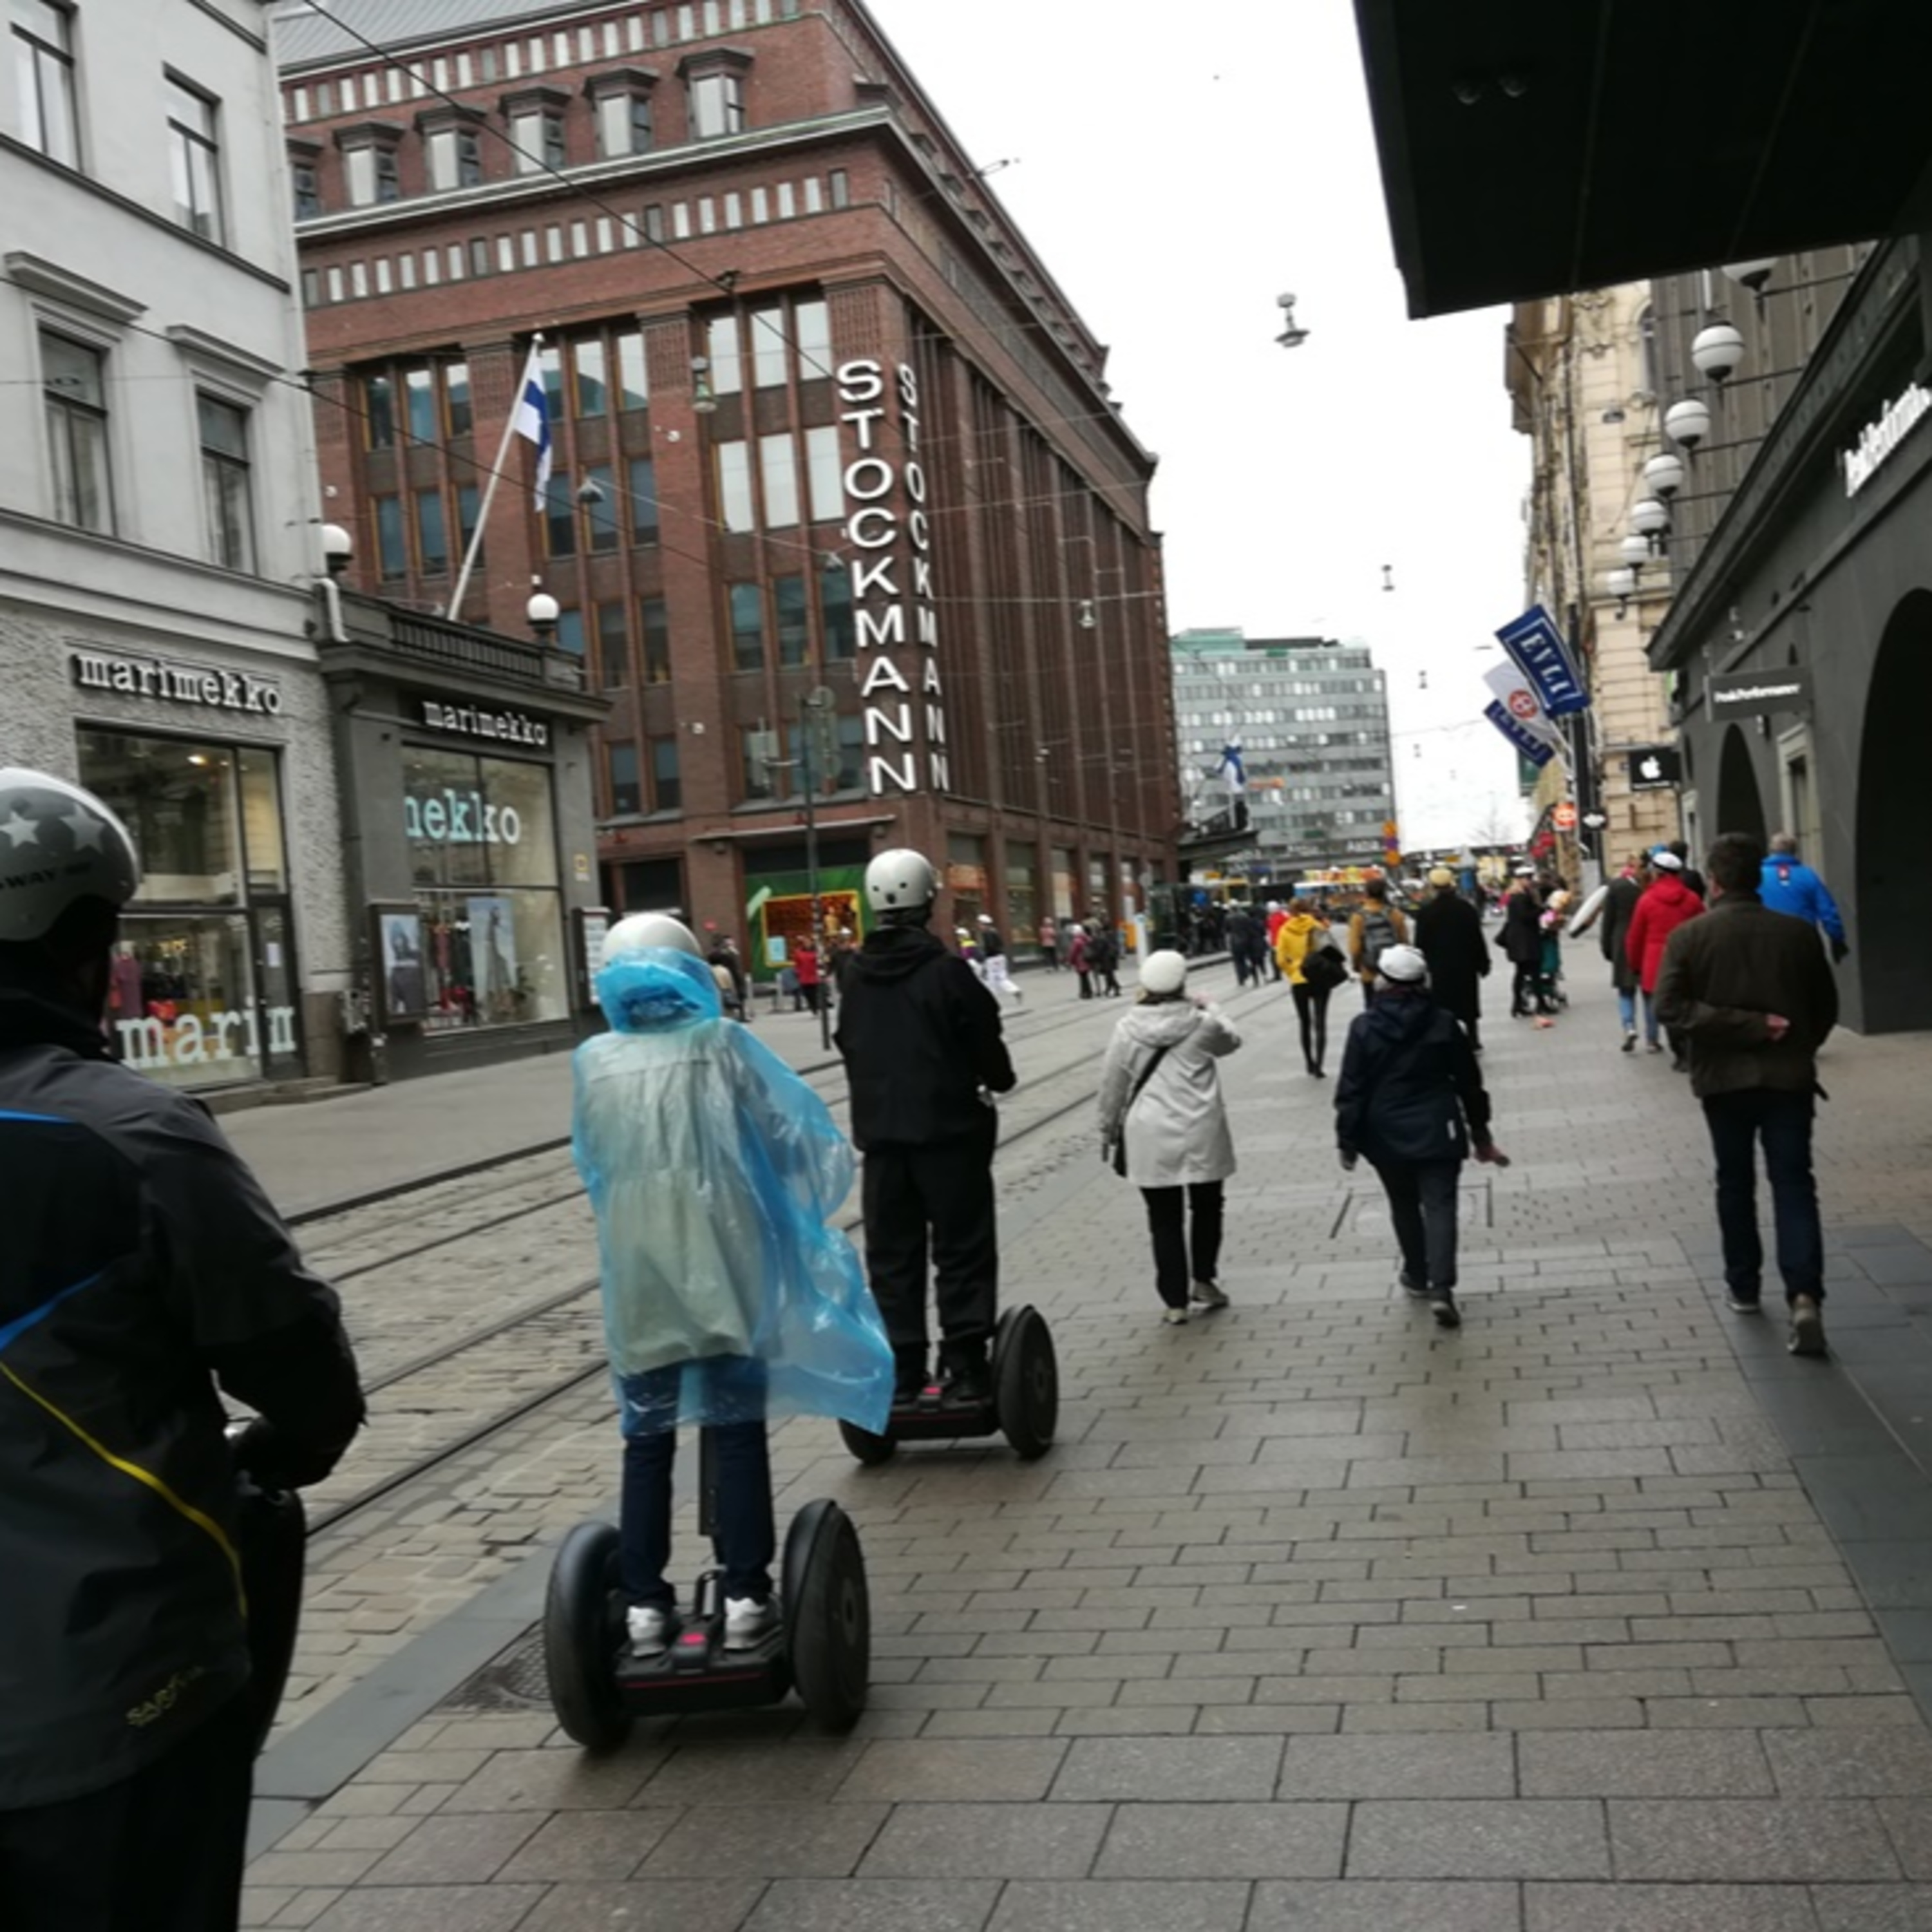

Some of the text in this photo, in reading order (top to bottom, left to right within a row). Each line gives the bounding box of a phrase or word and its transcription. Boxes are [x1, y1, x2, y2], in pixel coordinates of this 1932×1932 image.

[837, 359, 916, 794] STOCKMANN
[899, 362, 949, 792] STOCKMANN
[77, 655, 281, 714] marimekko
[1520, 632, 1571, 694] EVLI
[422, 701, 546, 745] marimekko
[0, 866, 57, 889] WAY
